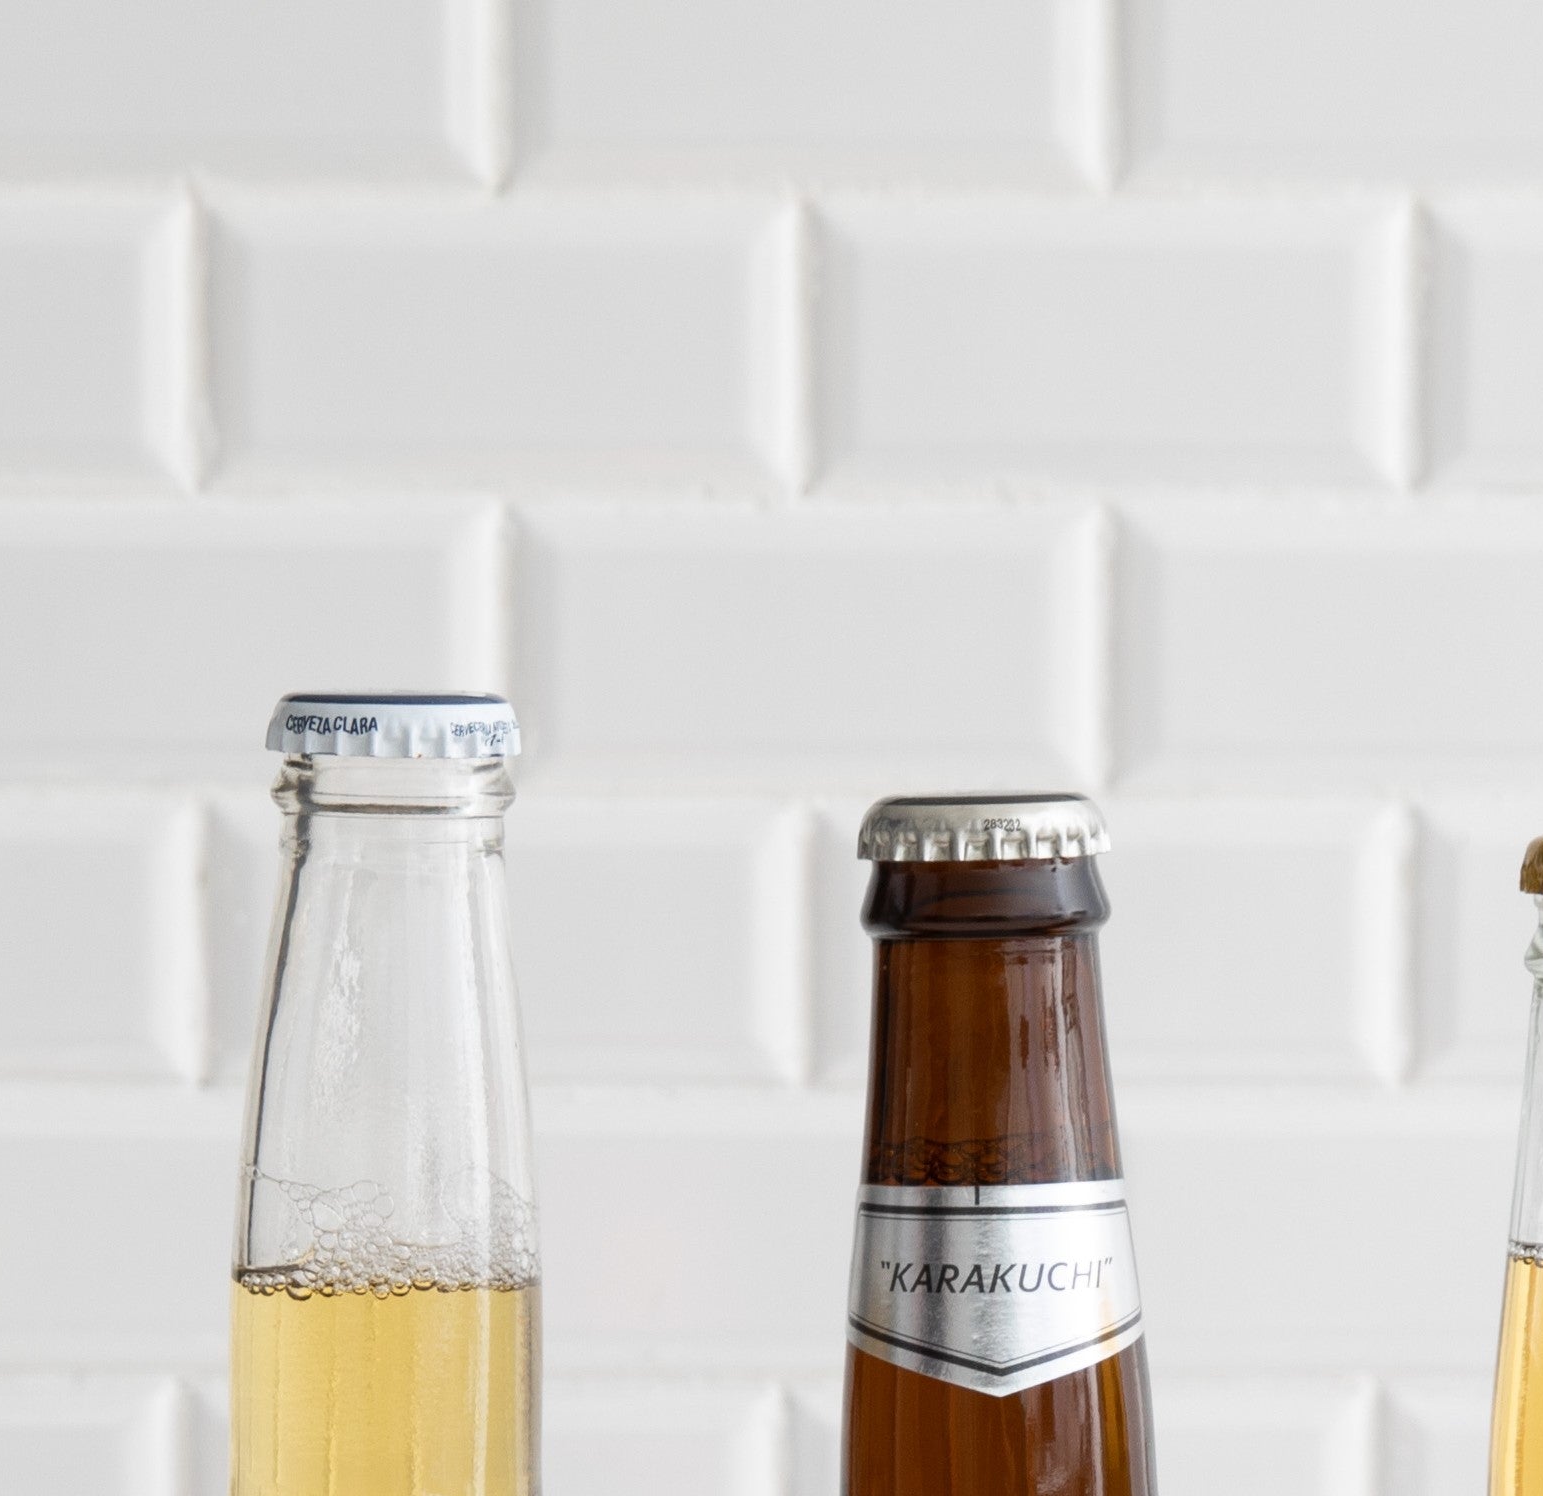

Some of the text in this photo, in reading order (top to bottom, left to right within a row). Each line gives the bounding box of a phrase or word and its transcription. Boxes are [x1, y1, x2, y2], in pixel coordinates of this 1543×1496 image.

[286, 715, 378, 735] CERVEZA CLARA
[880, 1256, 1113, 1294] "KARAKUCHI"
